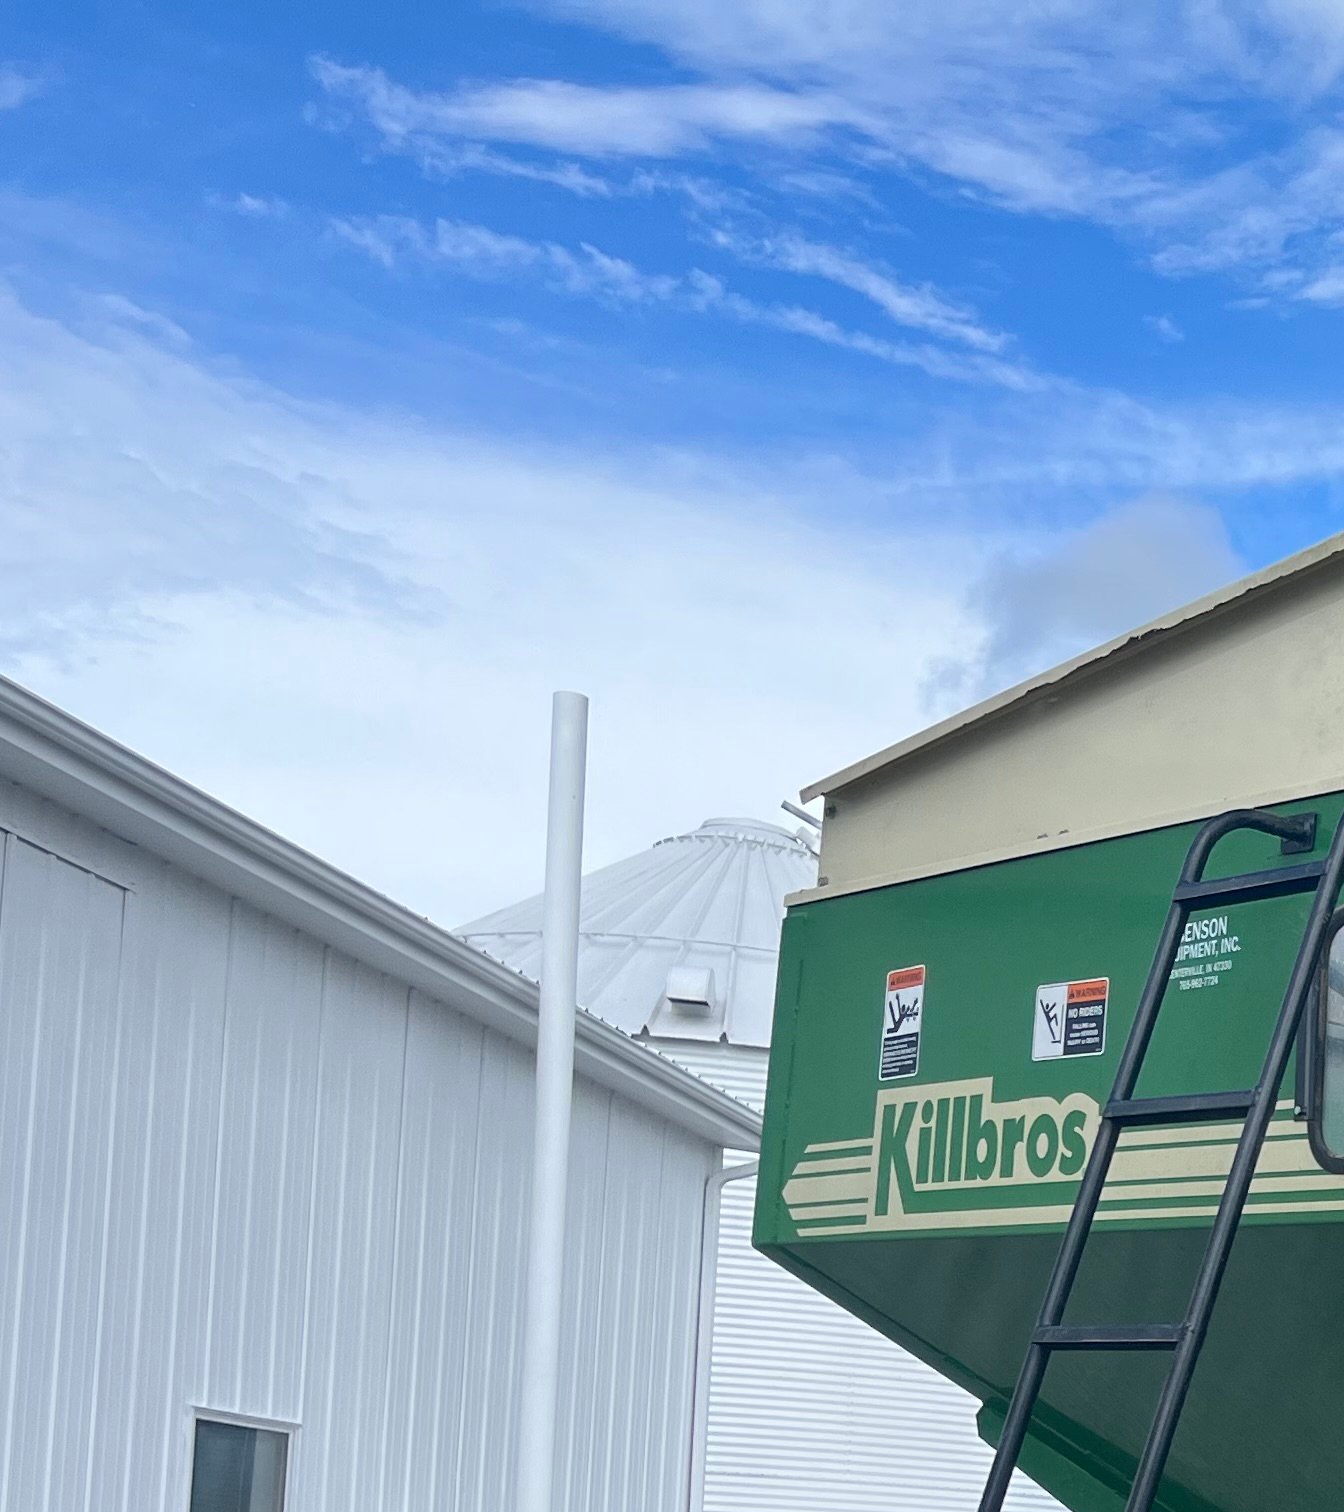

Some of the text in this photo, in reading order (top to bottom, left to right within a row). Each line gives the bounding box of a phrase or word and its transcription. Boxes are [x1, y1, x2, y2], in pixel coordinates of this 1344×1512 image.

[1181, 915, 1228, 943] ENSON
[1220, 935, 1242, 954] INC.
[874, 1093, 1087, 1217] Killbros
